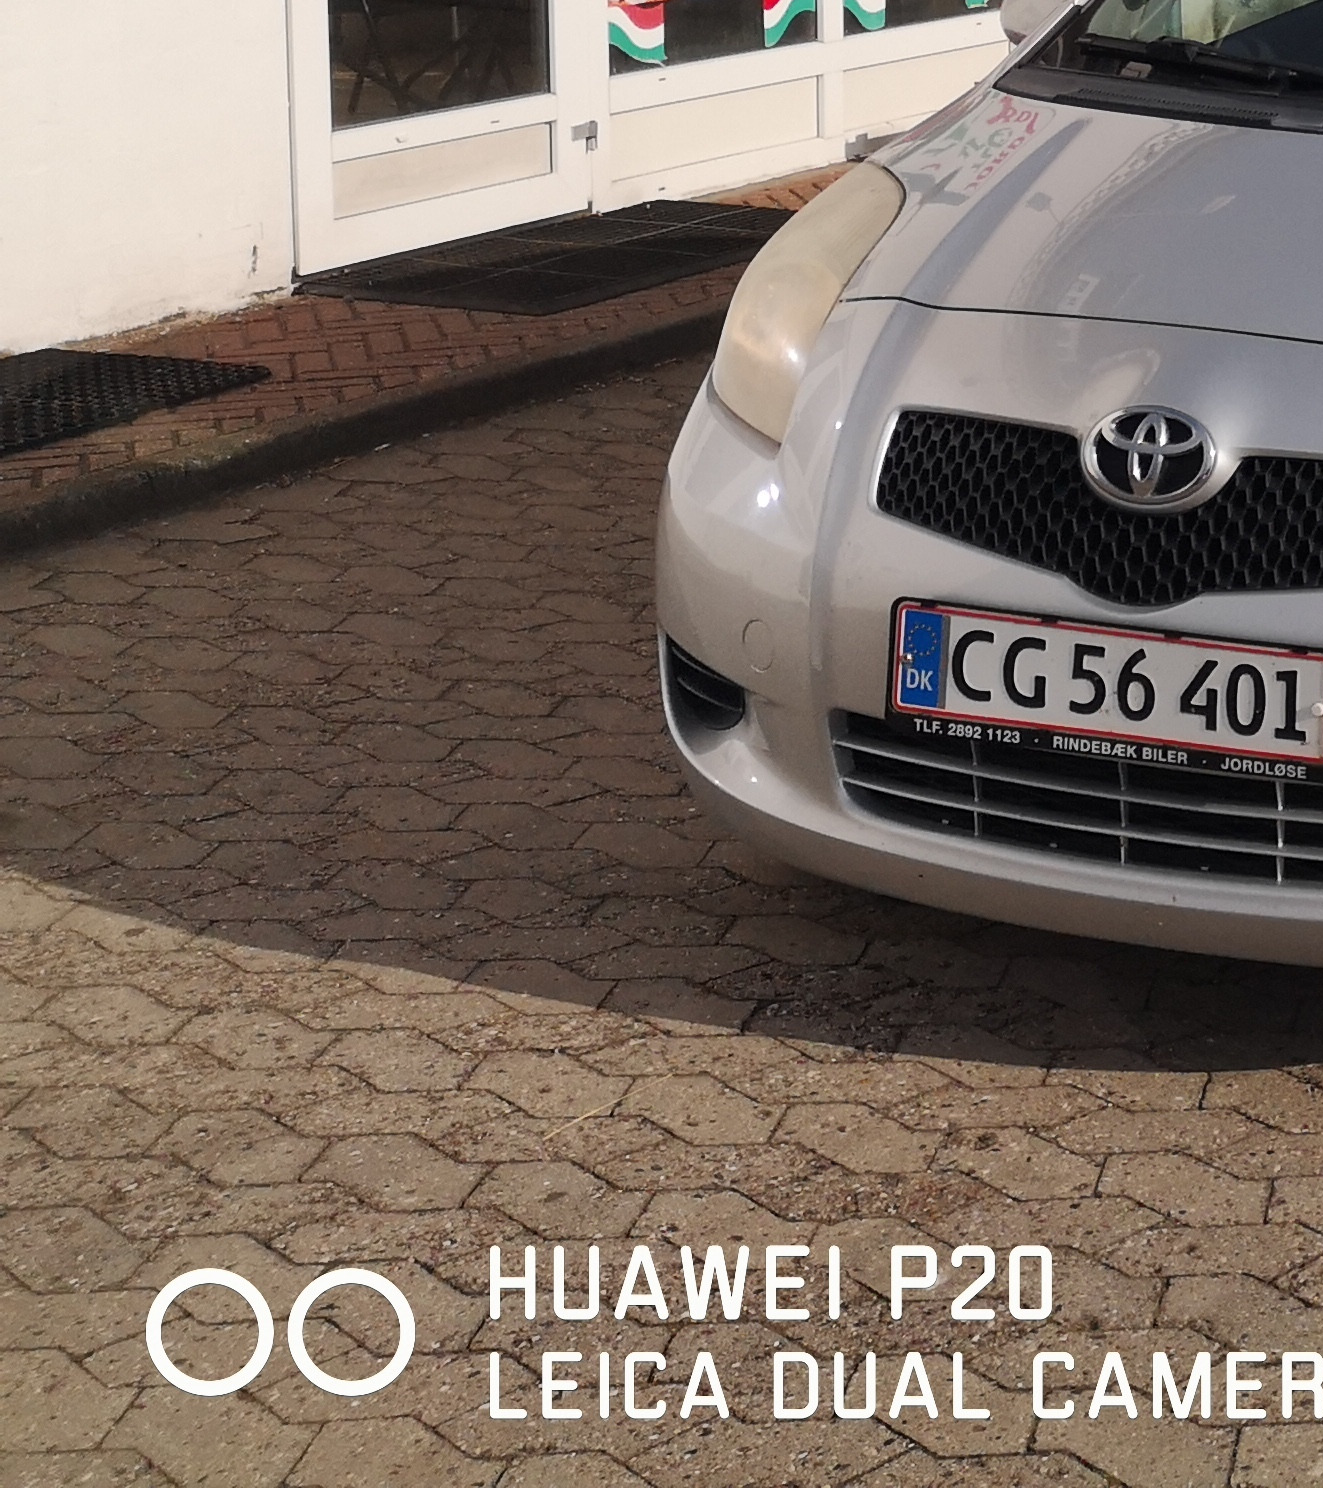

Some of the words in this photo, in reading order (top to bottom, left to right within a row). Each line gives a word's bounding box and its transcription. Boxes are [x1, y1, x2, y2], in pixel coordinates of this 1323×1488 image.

[905, 667, 934, 692] DK
[951, 629, 1047, 710] CG
[1068, 642, 1156, 722] 56
[1179, 659, 1307, 744] 401
[913, 718, 943, 735] TLF.
[947, 722, 982, 740] 2892
[986, 727, 1021, 744] 1123
[1052, 735, 1138, 759] RINDEBÆK
[1141, 746, 1189, 765] BILER
[1220, 756, 1308, 779] JORDLØSE
